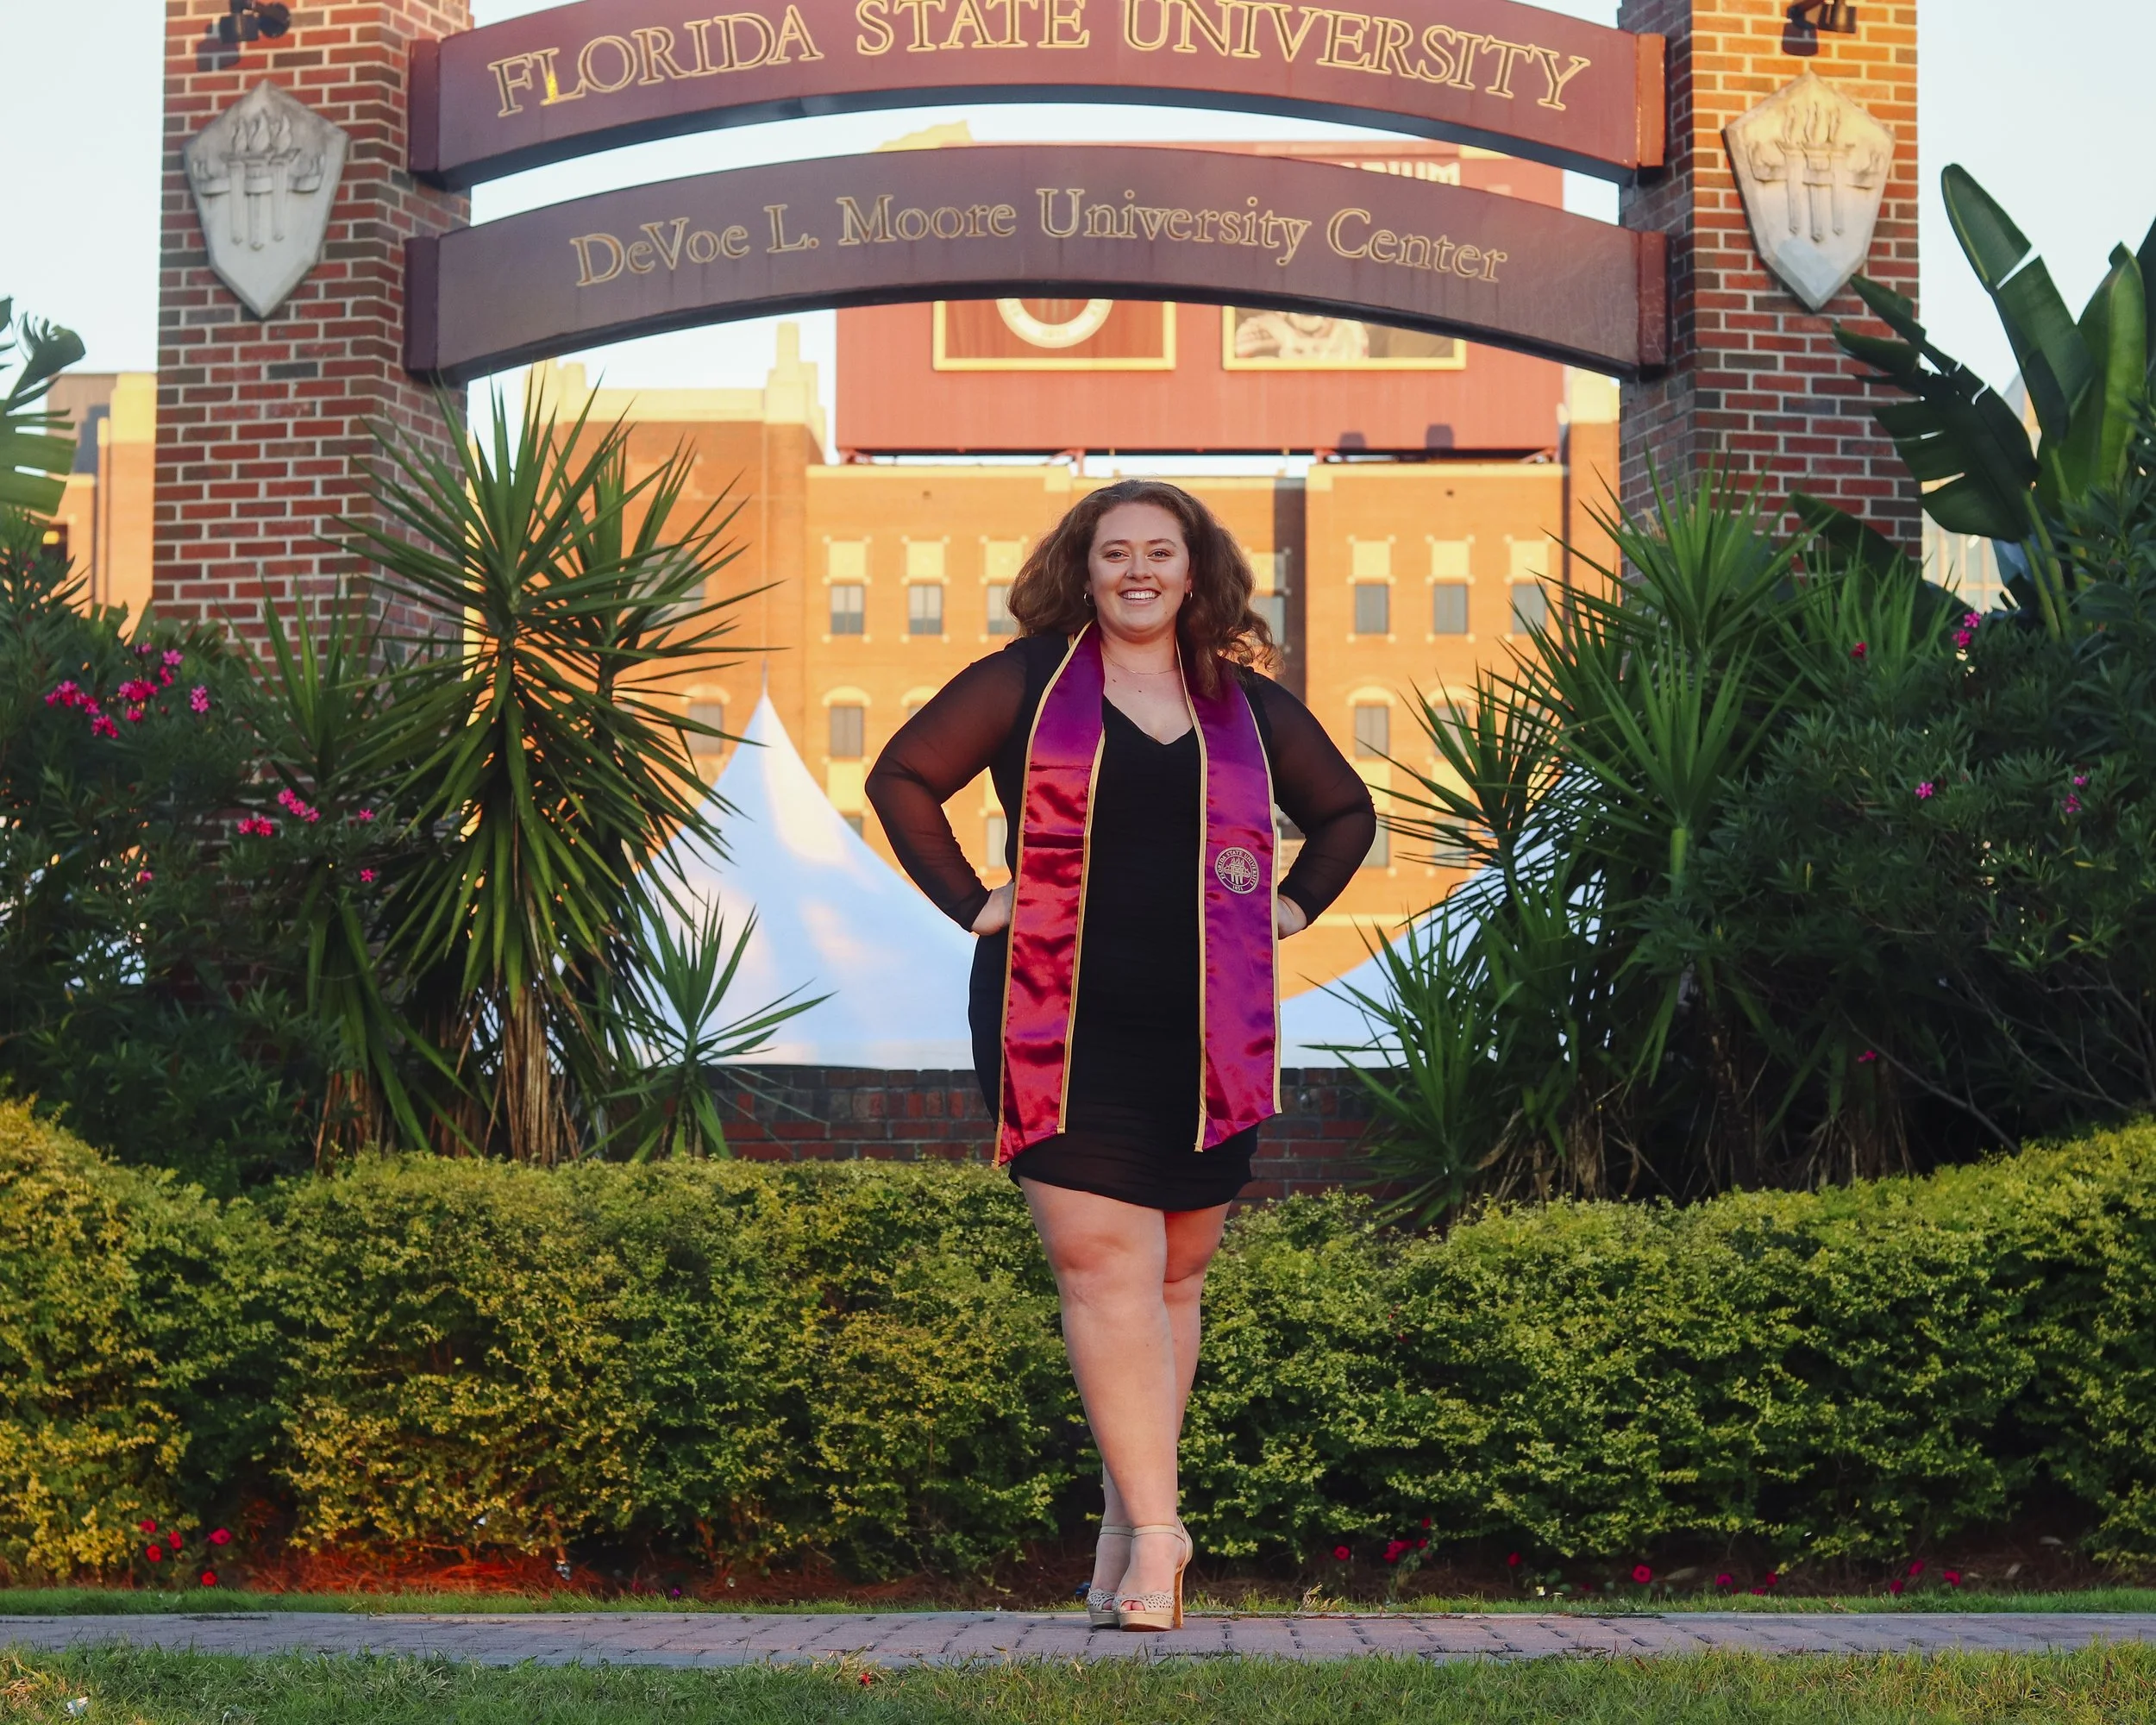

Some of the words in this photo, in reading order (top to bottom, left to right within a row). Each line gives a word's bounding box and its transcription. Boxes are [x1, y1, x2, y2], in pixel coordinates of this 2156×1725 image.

[487, 4, 824, 117] FLORIDA
[856, 0, 1090, 55] STATE
[1123, 0, 1590, 111] UNIVERSITY
[569, 216, 749, 287] DeVoe
[763, 204, 819, 254] L.
[836, 194, 1017, 247] Moore
[1037, 188, 1312, 266] University
[1326, 208, 1507, 283] Center
